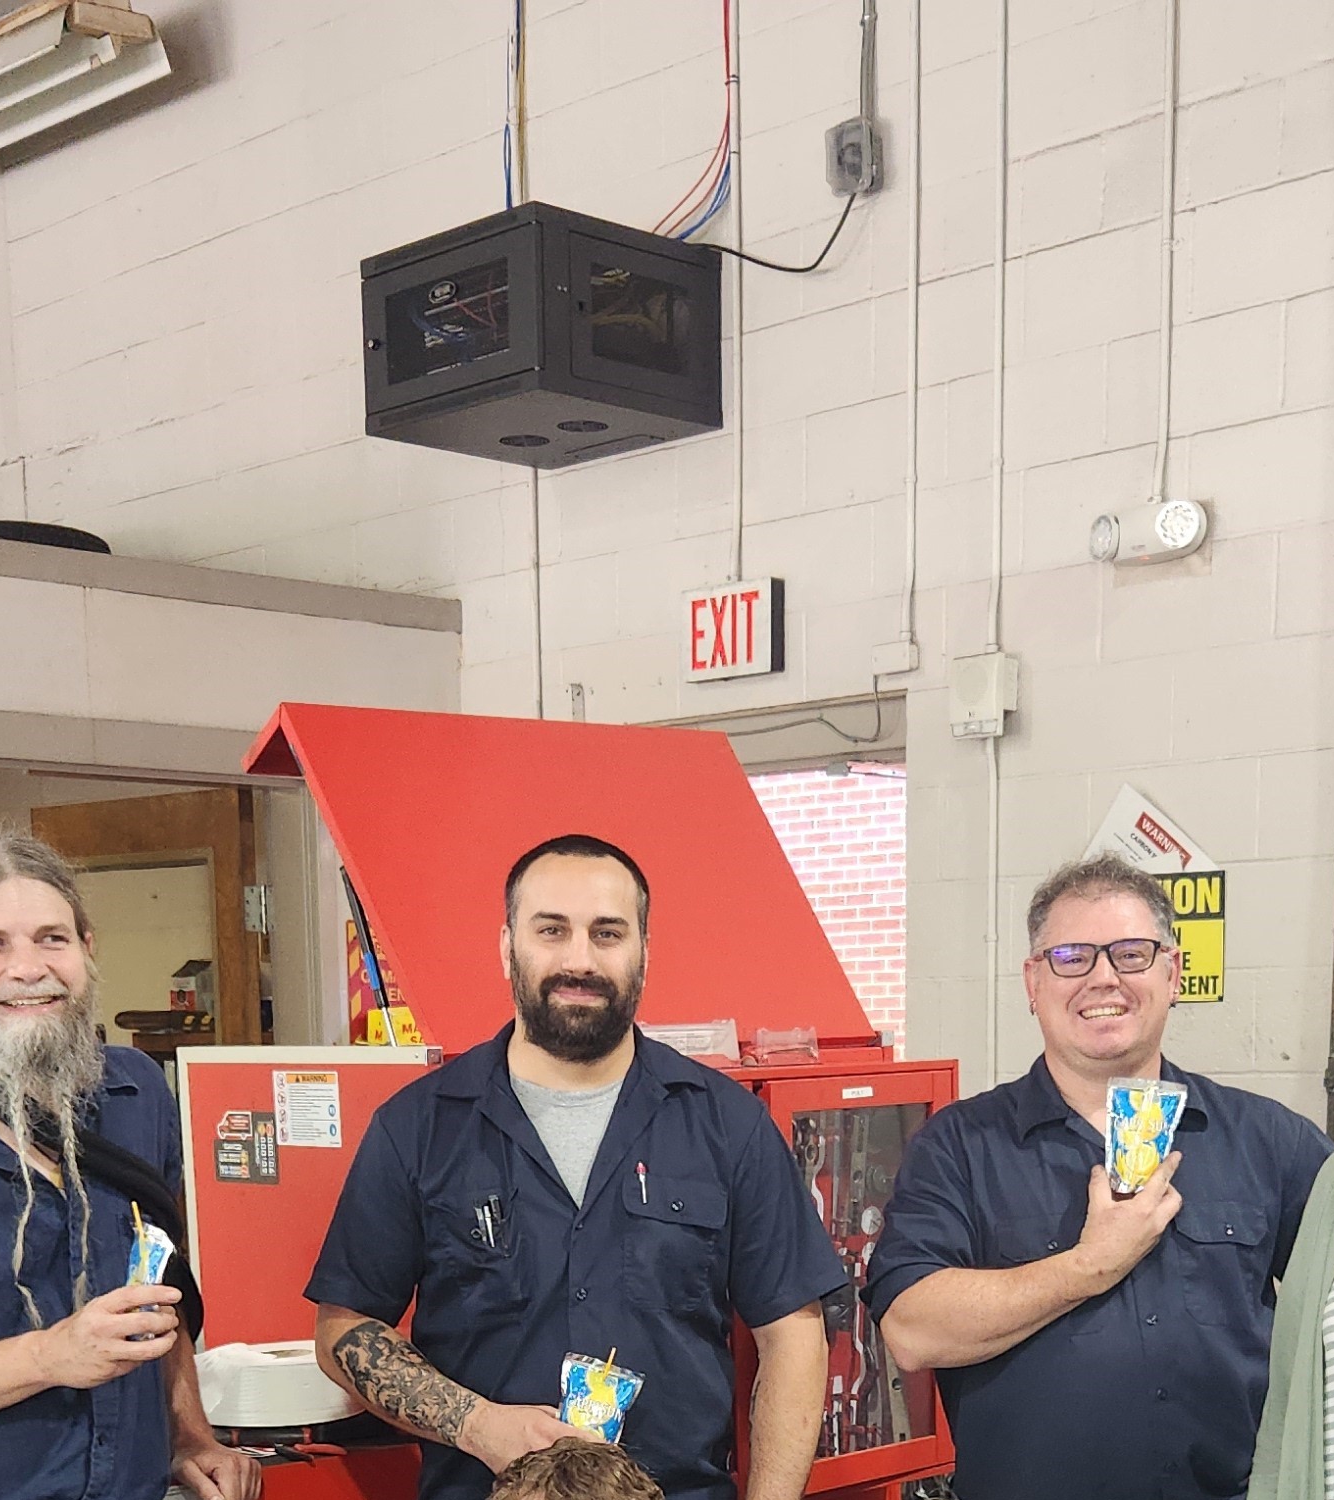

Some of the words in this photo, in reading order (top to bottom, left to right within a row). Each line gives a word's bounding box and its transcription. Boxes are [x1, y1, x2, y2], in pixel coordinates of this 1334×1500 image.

[691, 590, 760, 671] EXIT
[1159, 877, 1221, 915] ION
[1179, 975, 1219, 996] SENT
